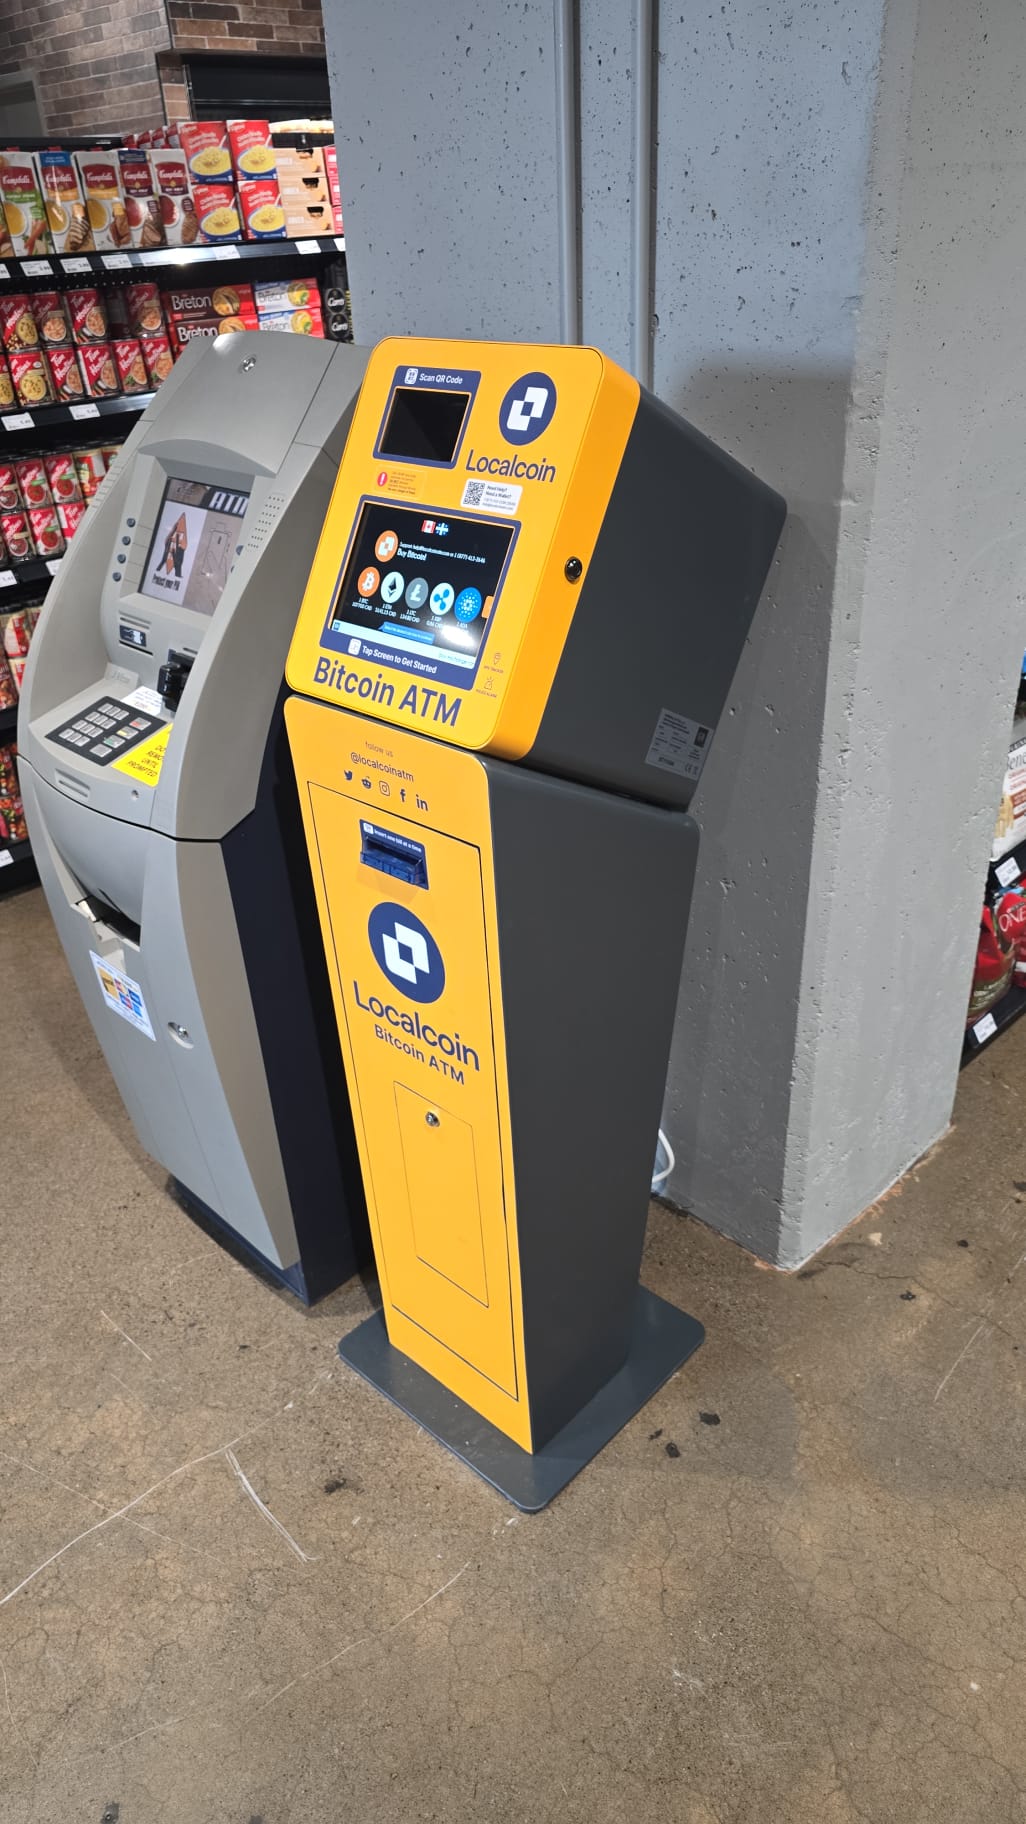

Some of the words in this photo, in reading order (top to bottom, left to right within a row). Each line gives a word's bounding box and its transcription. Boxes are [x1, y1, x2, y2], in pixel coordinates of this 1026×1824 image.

[172, 295, 212, 310] Breton
[178, 325, 218, 342] Breton
[419, 373, 436, 382] Scan
[436, 374, 445, 383] QR
[446, 375, 463, 384] Code
[466, 449, 556, 482] Localcoin
[397, 548, 408, 558] Buy
[152, 573, 165, 586] Protect
[362, 645, 373, 656] Tap
[373, 649, 394, 662] Screen
[394, 655, 401, 664] to
[401, 657, 413, 667] Get
[413, 660, 438, 674] Started
[313, 656, 395, 706] Bitcoin
[398, 684, 462, 727] ATM
[365, 741, 384, 753] follow
[385, 749, 394, 757] us
[350, 752, 414, 782] @localcoinatm
[374, 829, 387, 838] Insert
[354, 980, 480, 1071] Localcoin
[375, 1023, 425, 1063] Bitcoin
[429, 1055, 465, 1085] ATM
